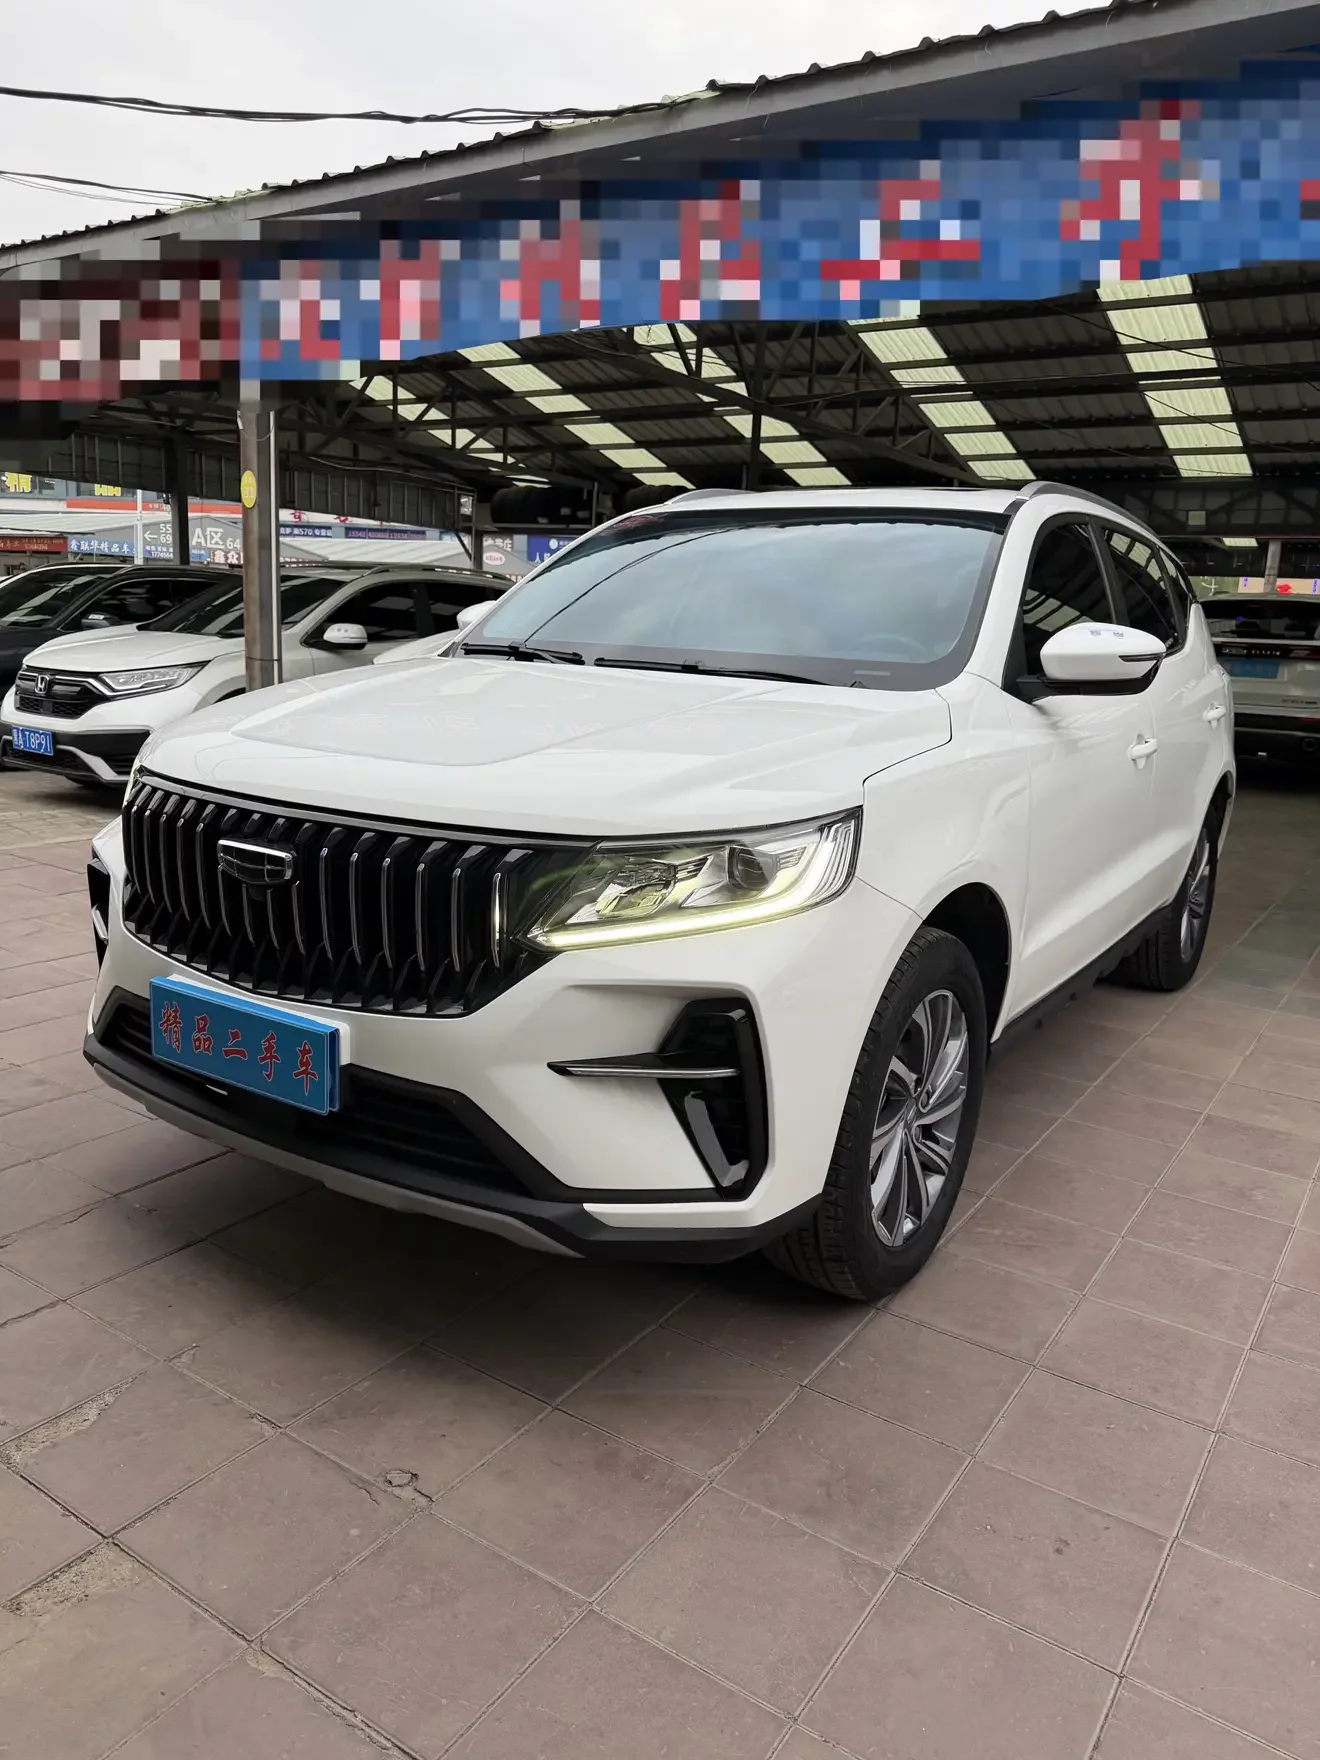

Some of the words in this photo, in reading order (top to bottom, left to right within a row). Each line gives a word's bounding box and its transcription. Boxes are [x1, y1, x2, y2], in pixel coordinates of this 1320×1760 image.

[160, 524, 172, 533] 55
[160, 534, 172, 544] 69
[192, 527, 225, 549] A区
[226, 538, 241, 550] 64
[159, 1000, 319, 1096] 精品二手车
